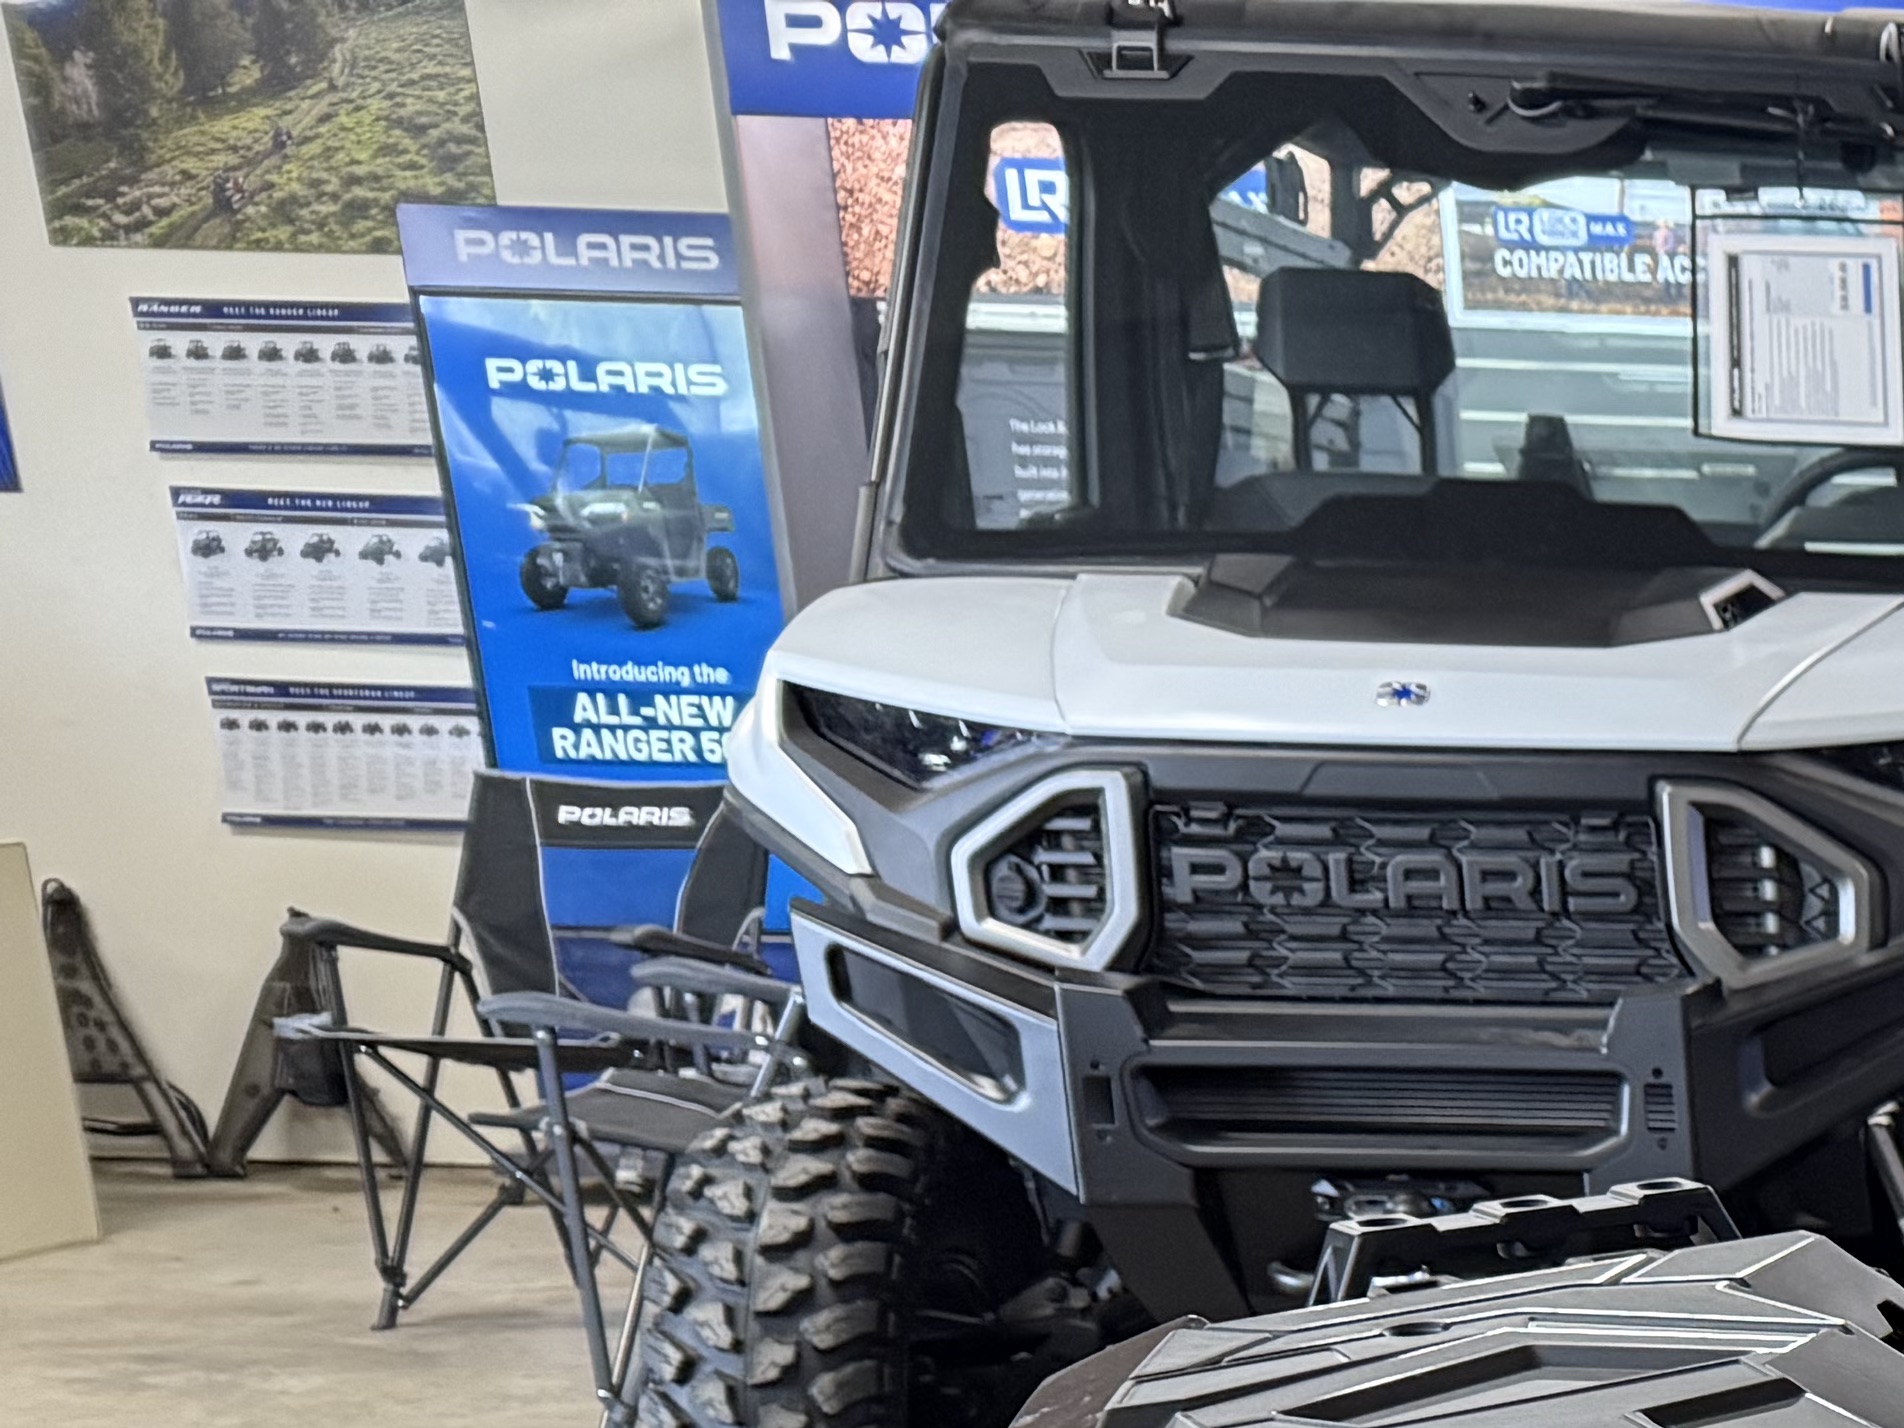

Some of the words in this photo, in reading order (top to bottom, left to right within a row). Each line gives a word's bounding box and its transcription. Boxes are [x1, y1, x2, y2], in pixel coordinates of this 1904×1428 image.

[454, 229, 720, 271] POLARIS
[1494, 248, 1653, 283] COMPATIBLE
[485, 357, 729, 396] POLARIS
[571, 659, 691, 688] Introducing
[693, 663, 733, 685] the
[573, 692, 735, 728] ALL-NEW
[551, 727, 701, 763] RANGER
[557, 805, 695, 828] POLARIS
[1170, 845, 1640, 913] POLARIS
